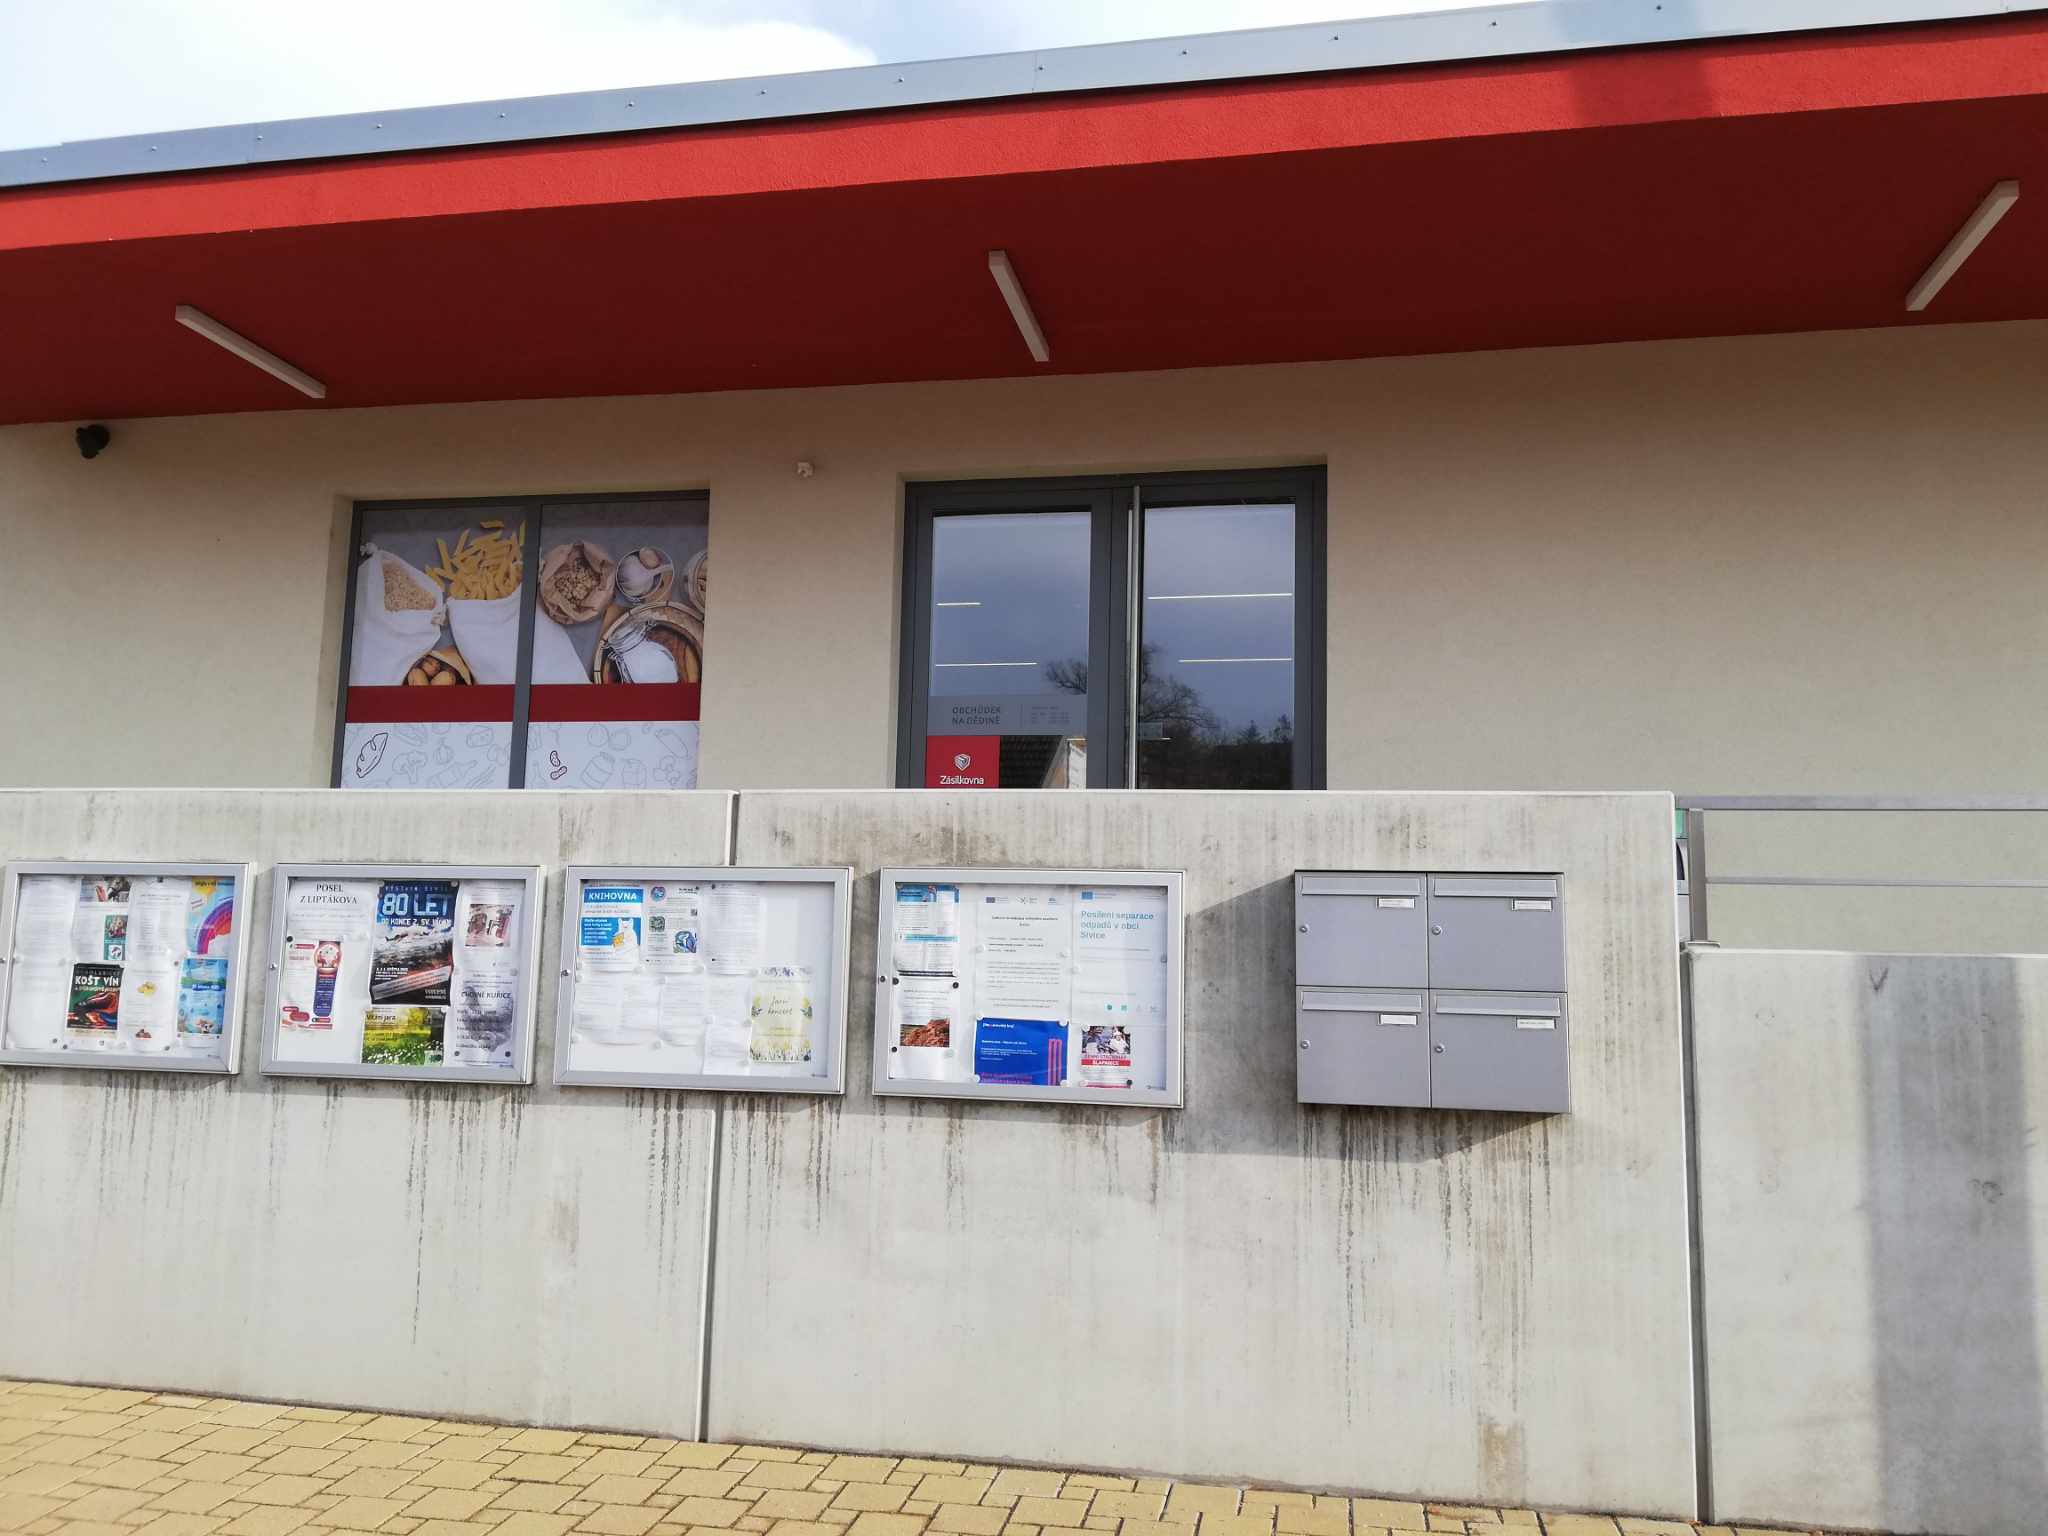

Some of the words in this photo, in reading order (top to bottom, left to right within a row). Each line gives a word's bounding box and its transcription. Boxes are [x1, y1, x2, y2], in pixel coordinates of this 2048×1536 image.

[952, 716, 965, 725] NA
[939, 775, 985, 786] Zásilkovna
[316, 883, 344, 893] POSEL
[299, 895, 306, 904] Z
[307, 894, 358, 905] LIPTÁKOVA
[588, 891, 638, 902] KNIHOVNA
[381, 892, 409, 916] 80
[413, 892, 450, 916] LET
[75, 974, 100, 986] KOŠT
[103, 974, 119, 986] VÍN
